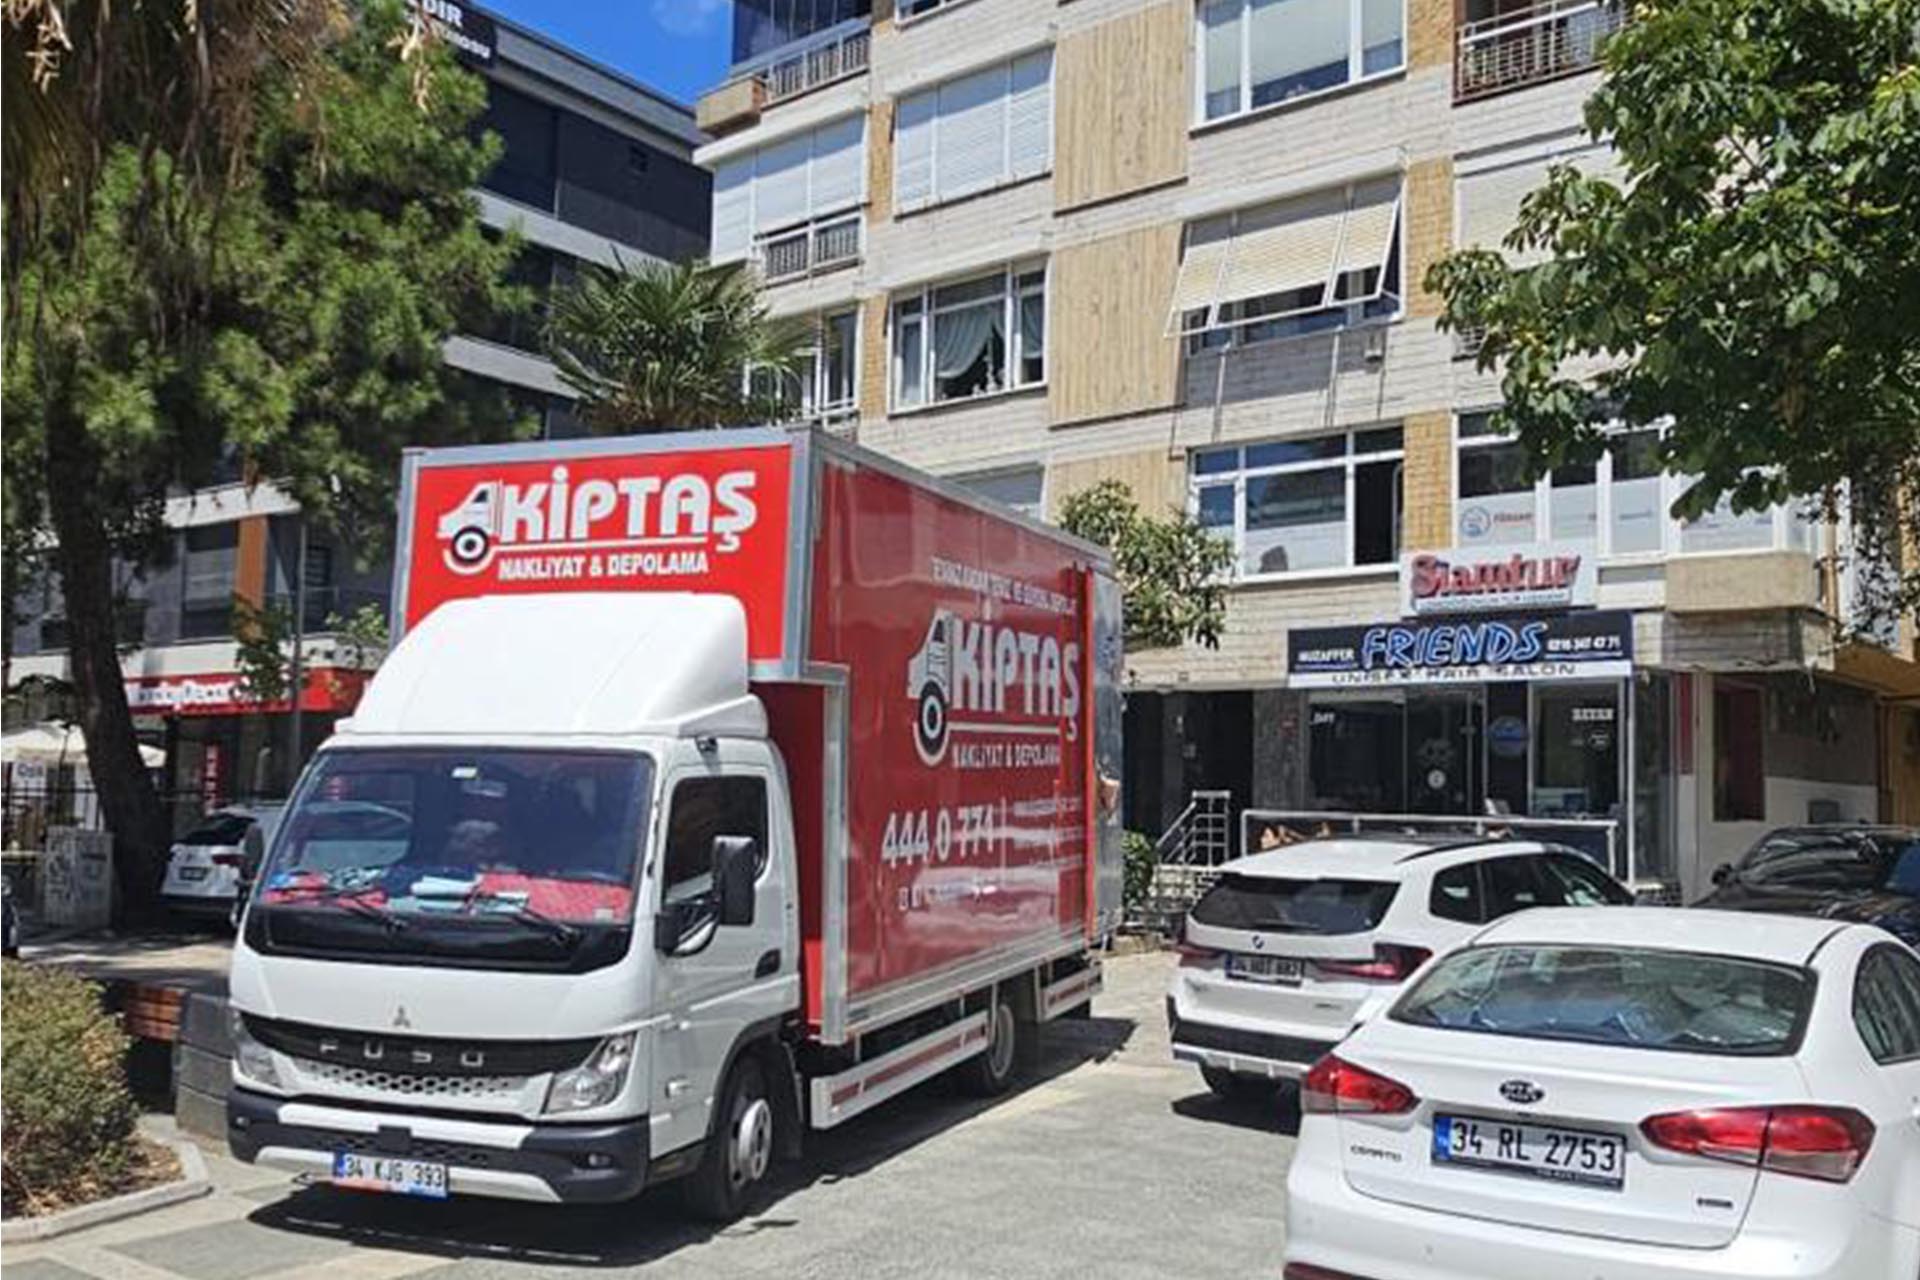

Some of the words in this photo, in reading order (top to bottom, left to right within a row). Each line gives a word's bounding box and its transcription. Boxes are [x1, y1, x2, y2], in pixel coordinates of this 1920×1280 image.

[502, 466, 757, 552] KİPTAŞ
[590, 555, 603, 577] &
[607, 551, 709, 576] DEPOLAMA
[1361, 621, 1548, 669] FRIENDS
[952, 599, 1080, 741] KİPTAŞ
[1426, 667, 1480, 679] HAIR
[1494, 664, 1576, 677] SALON
[881, 811, 930, 869] 444
[936, 807, 951, 862] 0
[319, 1040, 484, 1067] FUSO
[1452, 1121, 1482, 1155] 34
[1498, 1127, 1534, 1161] RL
[1545, 1134, 1616, 1172] 2753
[346, 1156, 363, 1176] 34
[412, 1164, 443, 1187] 393
